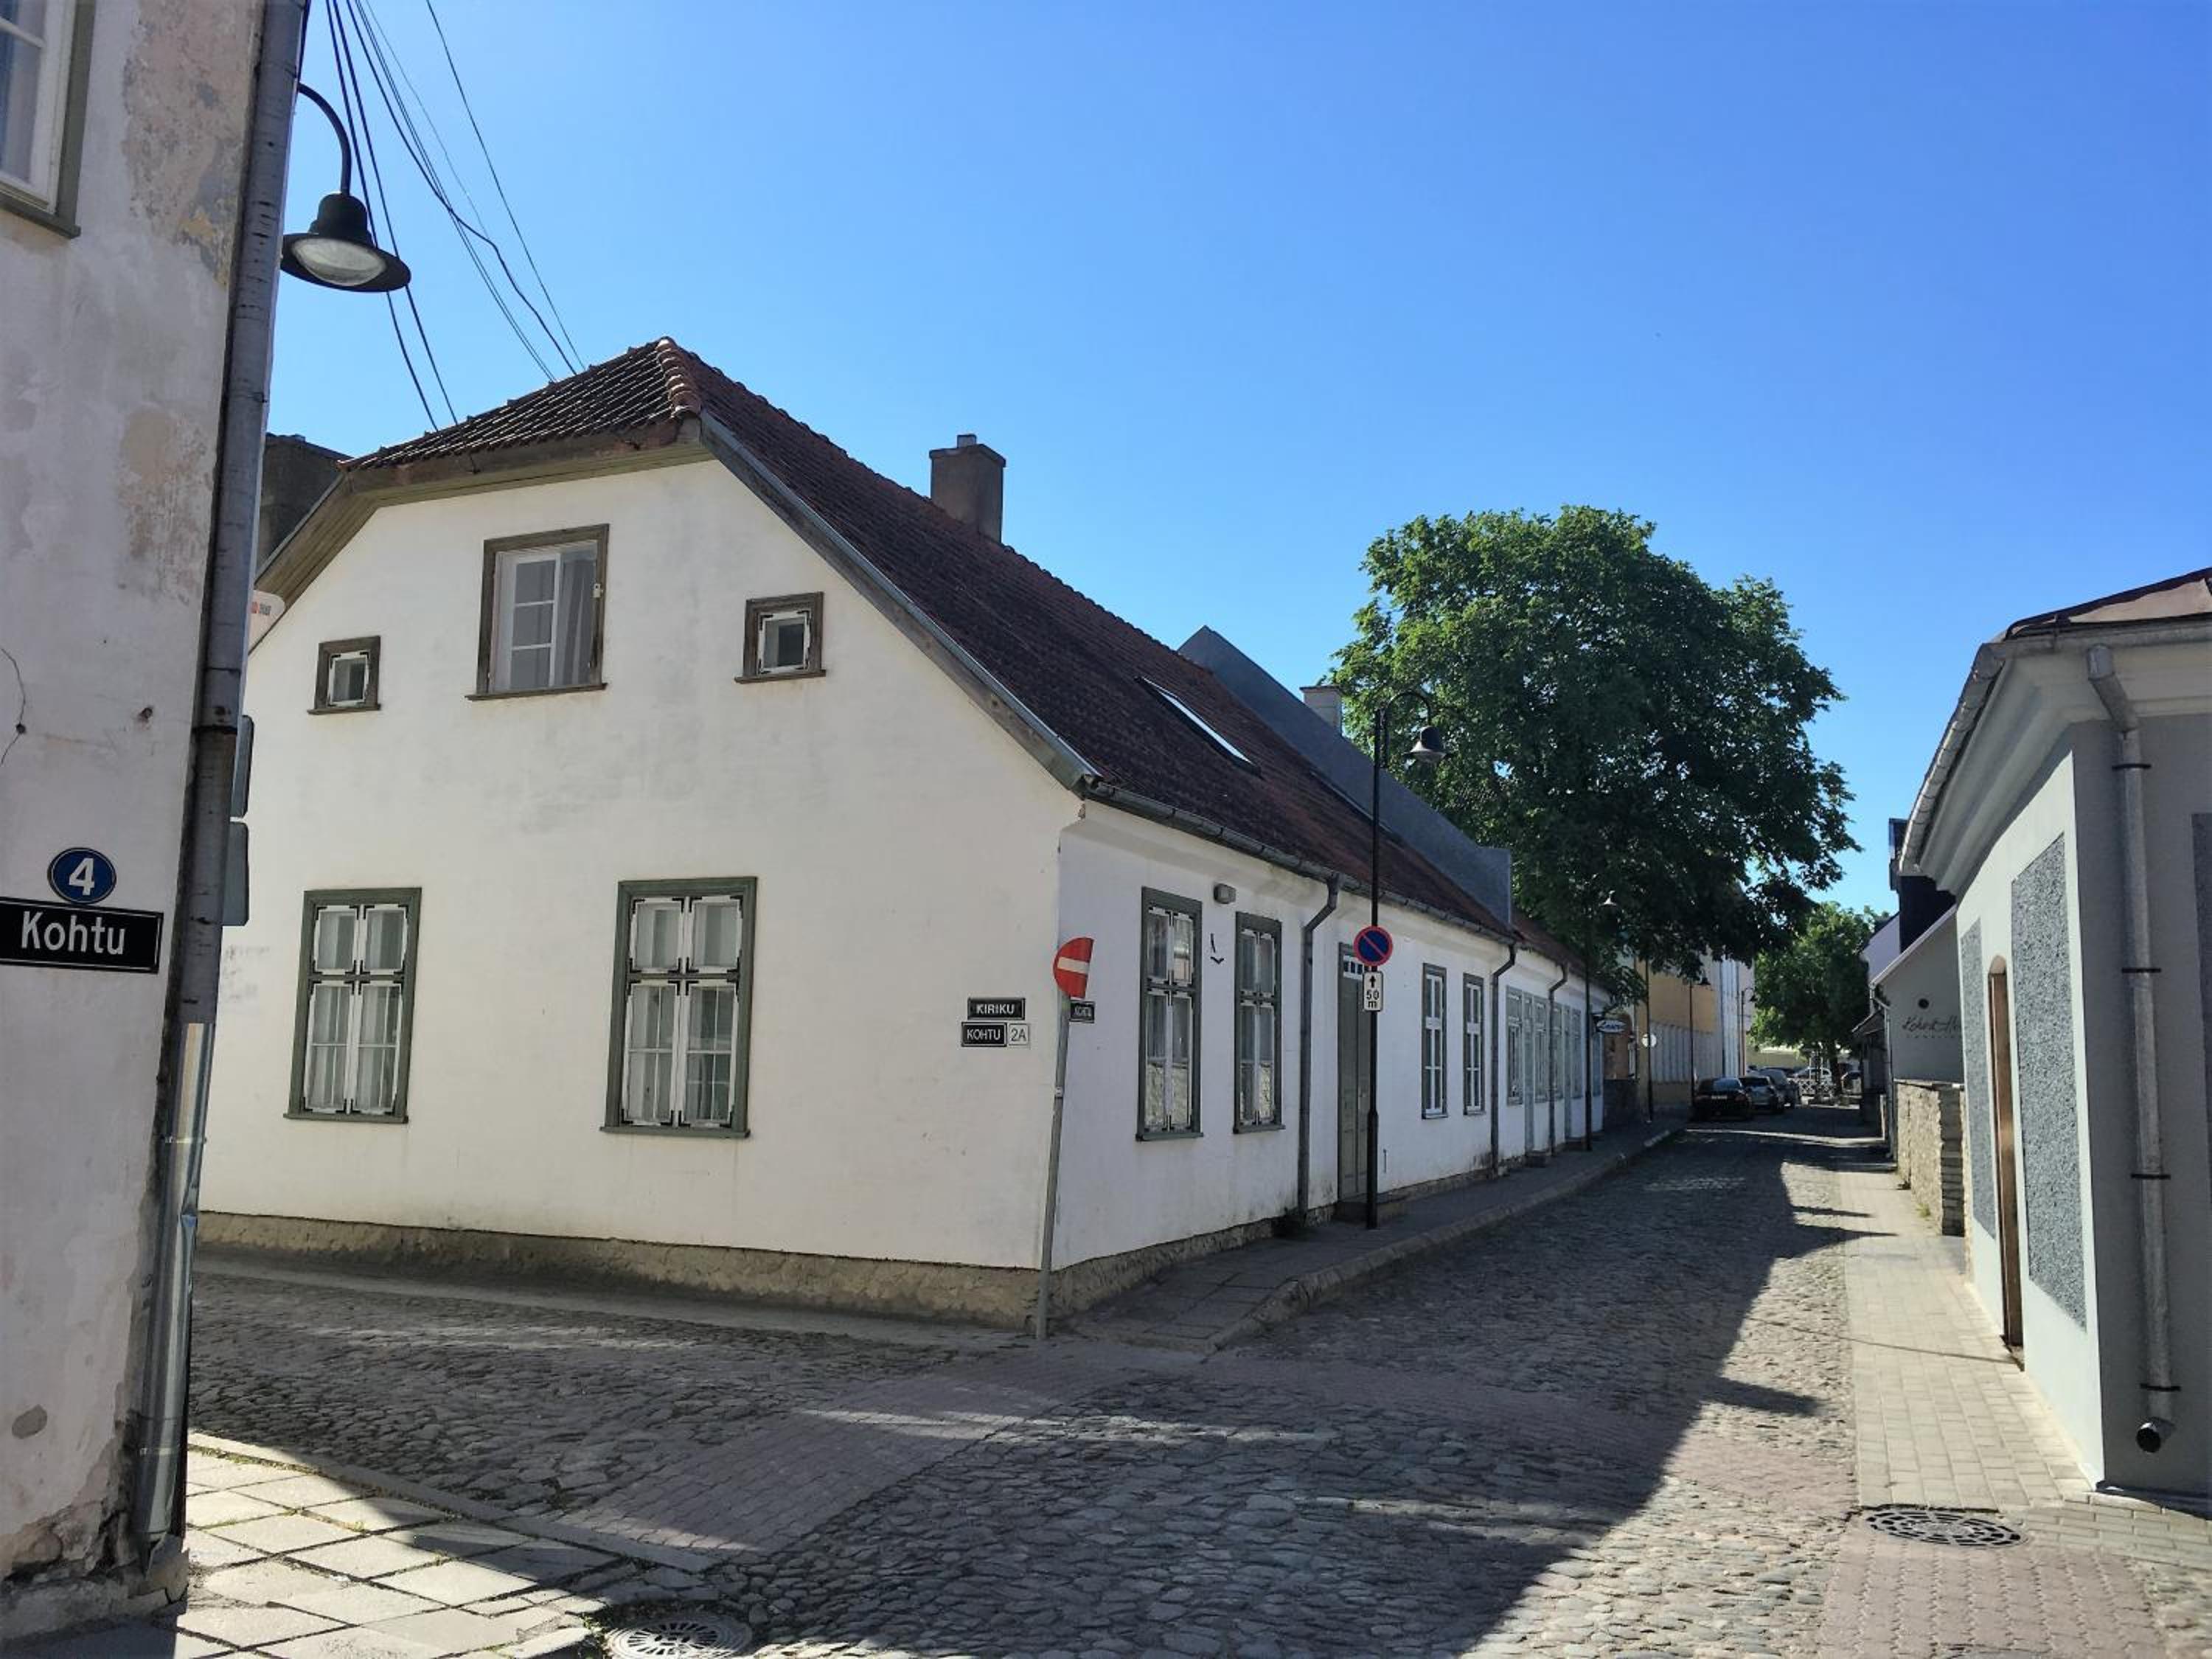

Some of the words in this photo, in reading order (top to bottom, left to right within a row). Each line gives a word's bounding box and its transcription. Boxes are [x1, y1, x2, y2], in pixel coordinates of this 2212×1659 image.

[69, 858, 95, 896] 4
[21, 911, 125, 955] Kohtu
[1366, 989, 1380, 1000] 50
[976, 1004, 1015, 1015] KIRIKU
[967, 1029, 1001, 1041] KOHTU
[1011, 1029, 1027, 1042] 2A
